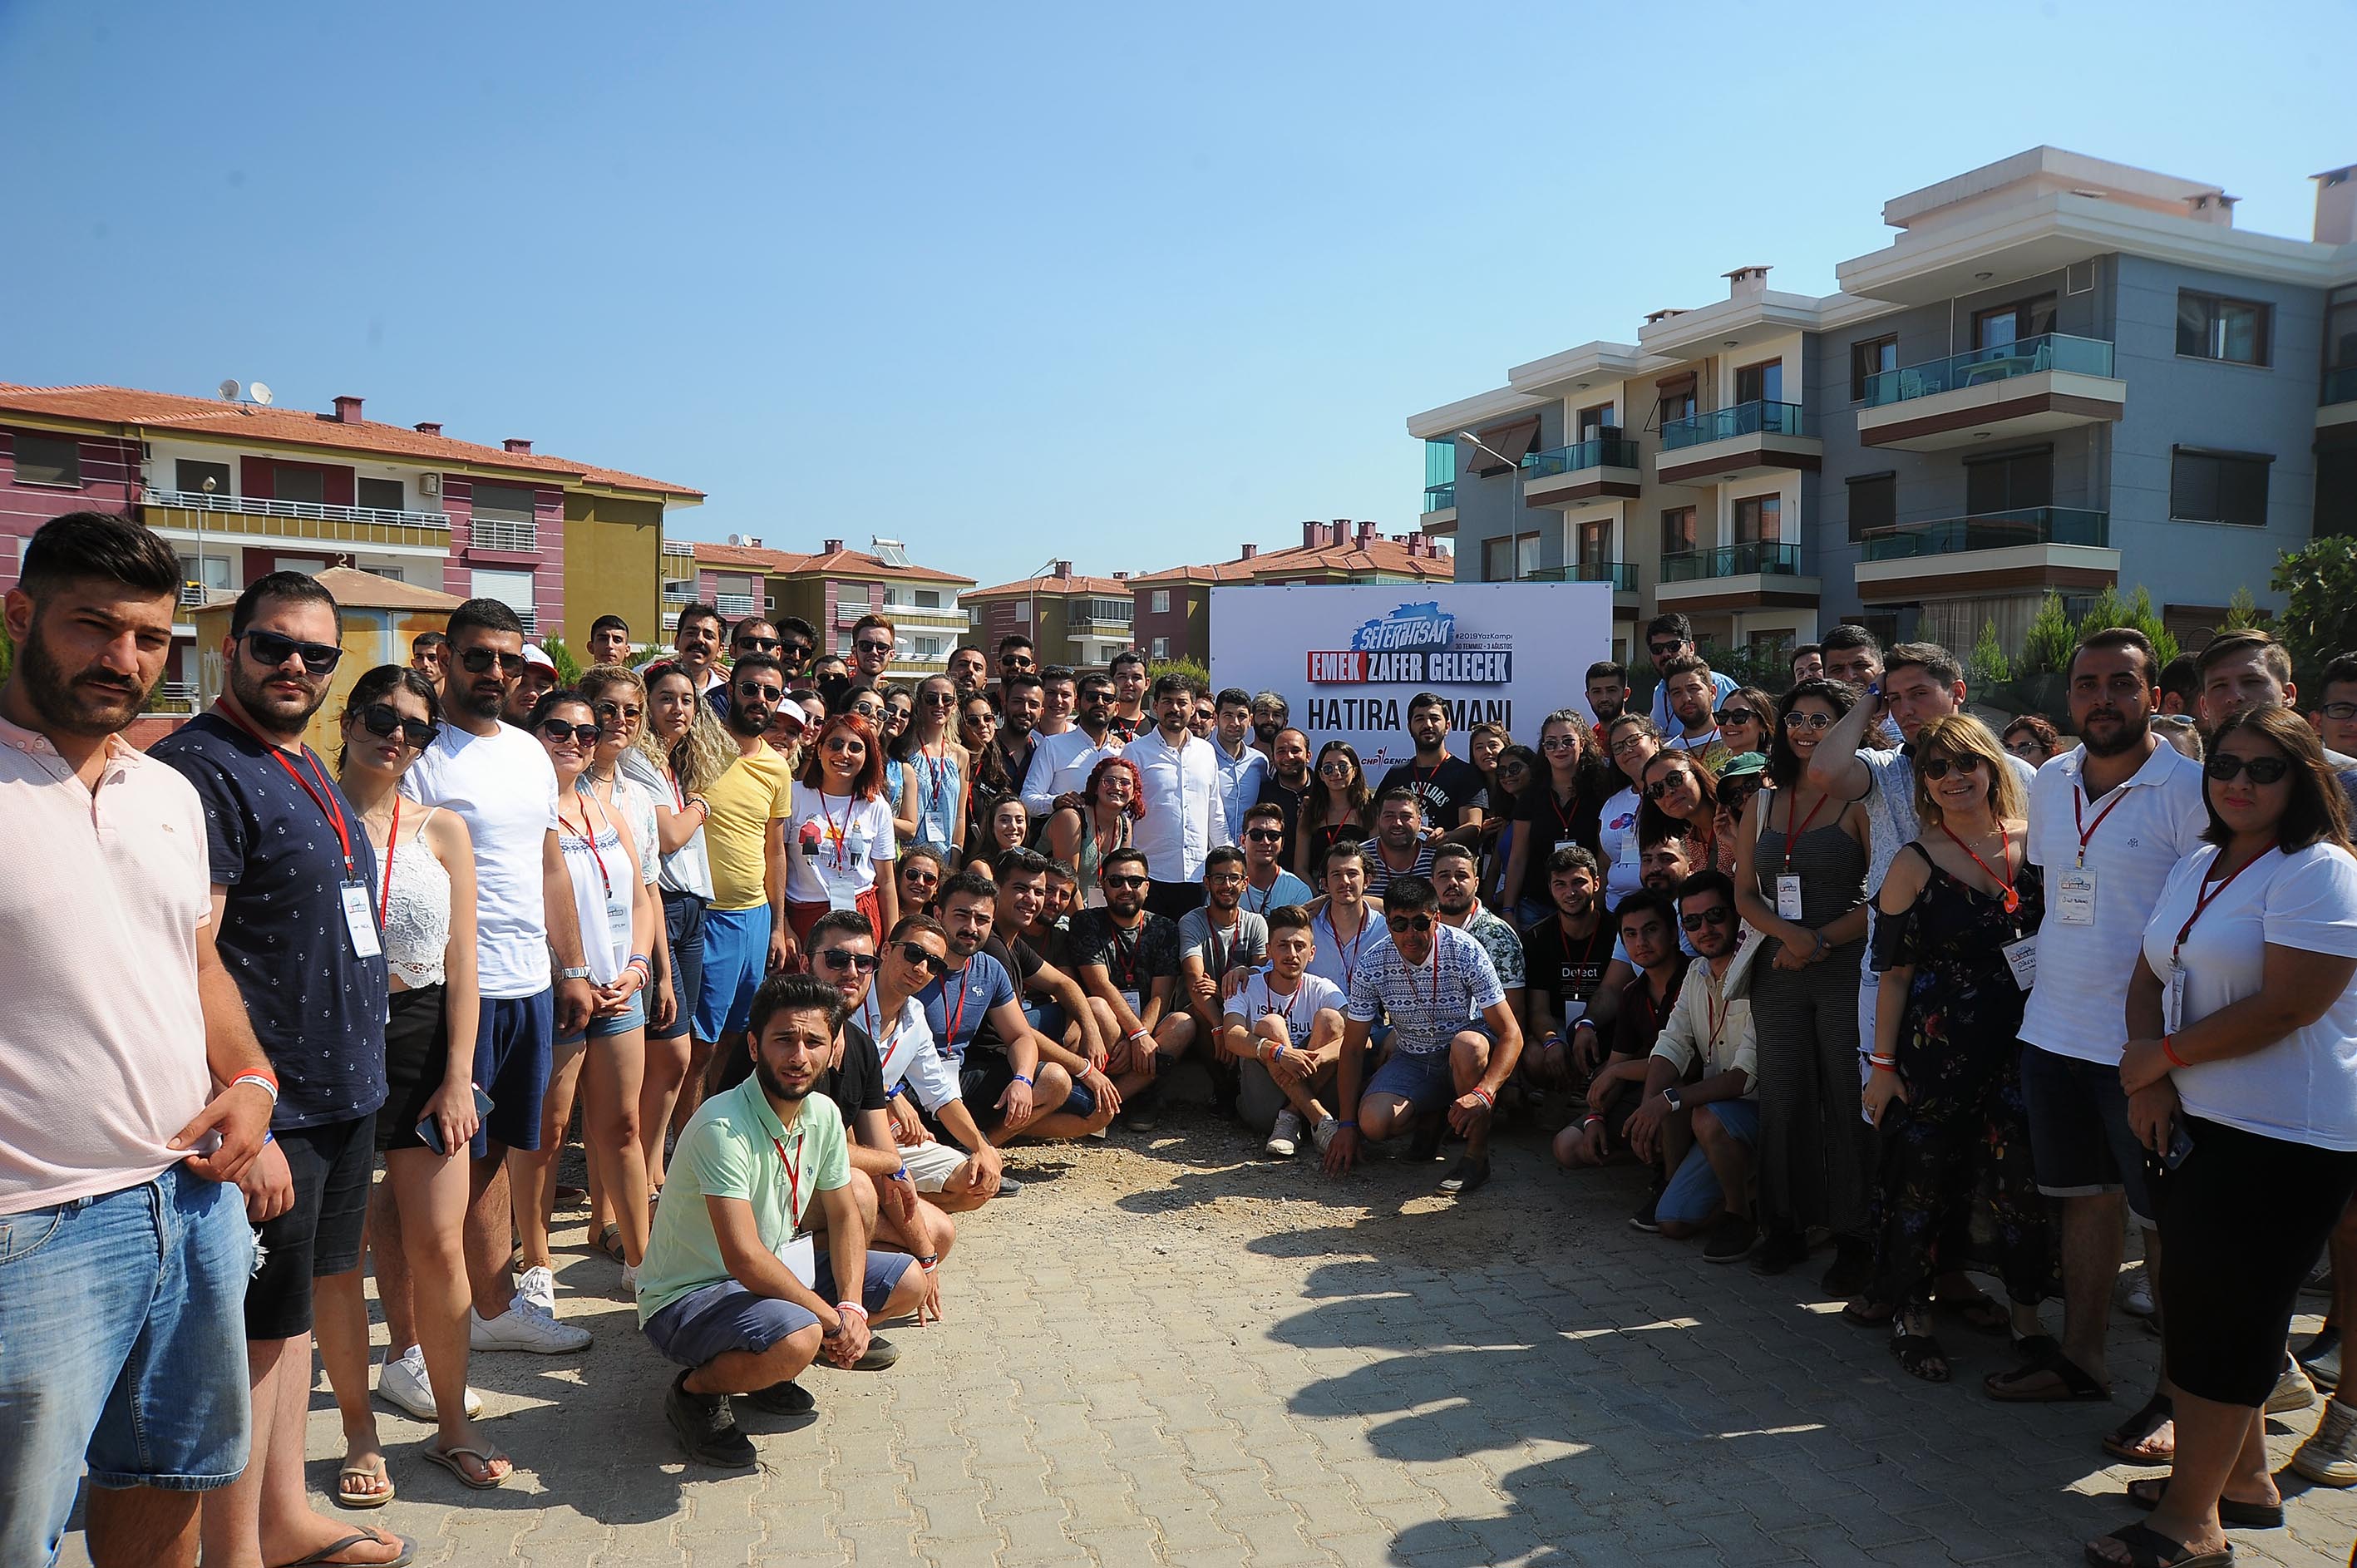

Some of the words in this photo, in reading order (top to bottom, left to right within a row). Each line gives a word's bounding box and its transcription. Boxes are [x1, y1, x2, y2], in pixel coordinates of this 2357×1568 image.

[1312, 653, 1360, 681] EMEK
[1368, 653, 1423, 682] ZAFER
[1429, 653, 1507, 682] GELECEK
[1308, 698, 1402, 732] HATIRA
[1444, 699, 1512, 732] MANI
